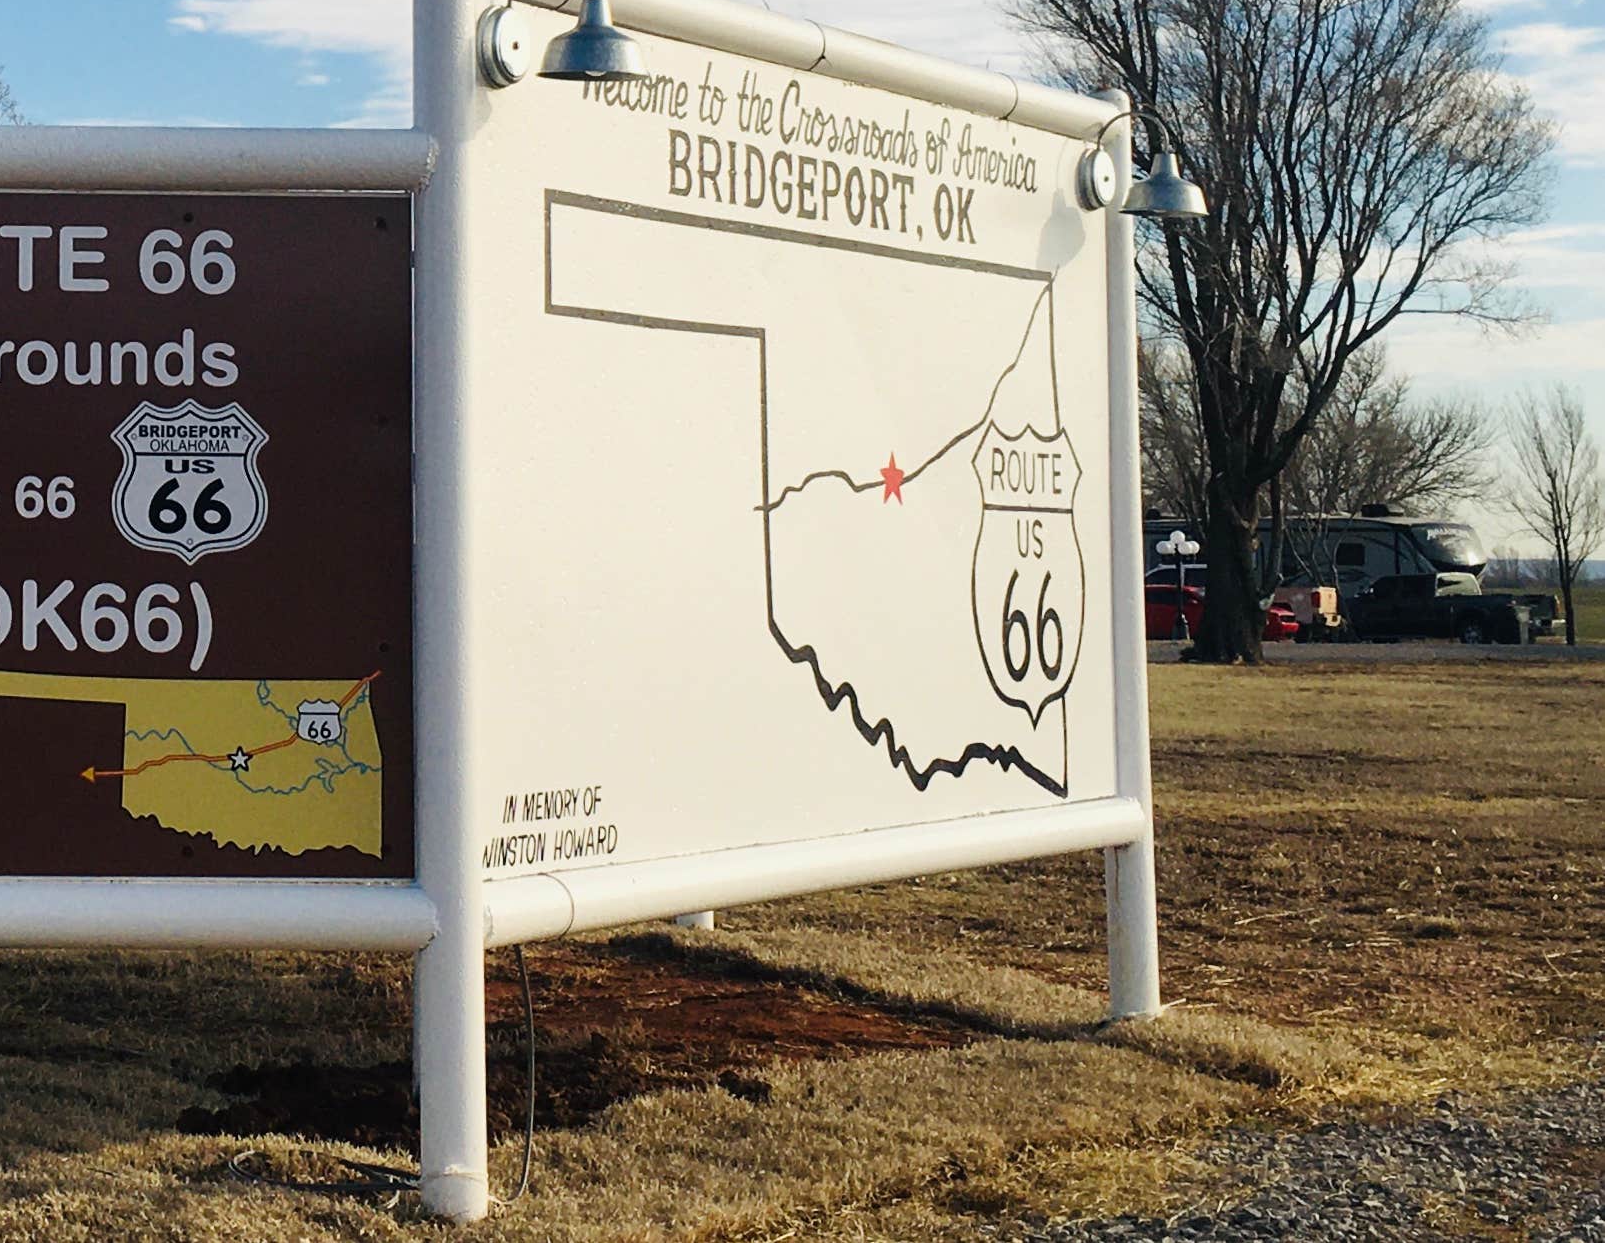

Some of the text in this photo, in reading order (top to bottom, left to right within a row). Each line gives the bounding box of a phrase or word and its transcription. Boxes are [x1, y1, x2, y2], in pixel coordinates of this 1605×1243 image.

[698, 62, 727, 125] to
[737, 70, 773, 136] the
[779, 79, 918, 168] Crossroads
[925, 117, 950, 175] of
[953, 123, 1038, 193] America
[668, 128, 977, 244] BRIDGEPORT, OK
[140, 229, 235, 294] 66
[139, 425, 241, 438] BRIDGEPORT
[150, 439, 230, 452] OKLAHOMA
[165, 459, 215, 474] US
[991, 447, 1062, 494] ROUTE
[15, 476, 76, 519] 66
[149, 477, 231, 535] 66
[1016, 519, 1044, 559] US
[1002, 569, 1063, 682] 66
[307, 720, 331, 739] 66
[502, 785, 602, 823] IN MEMORY OF
[553, 825, 618, 860] HOWARD
